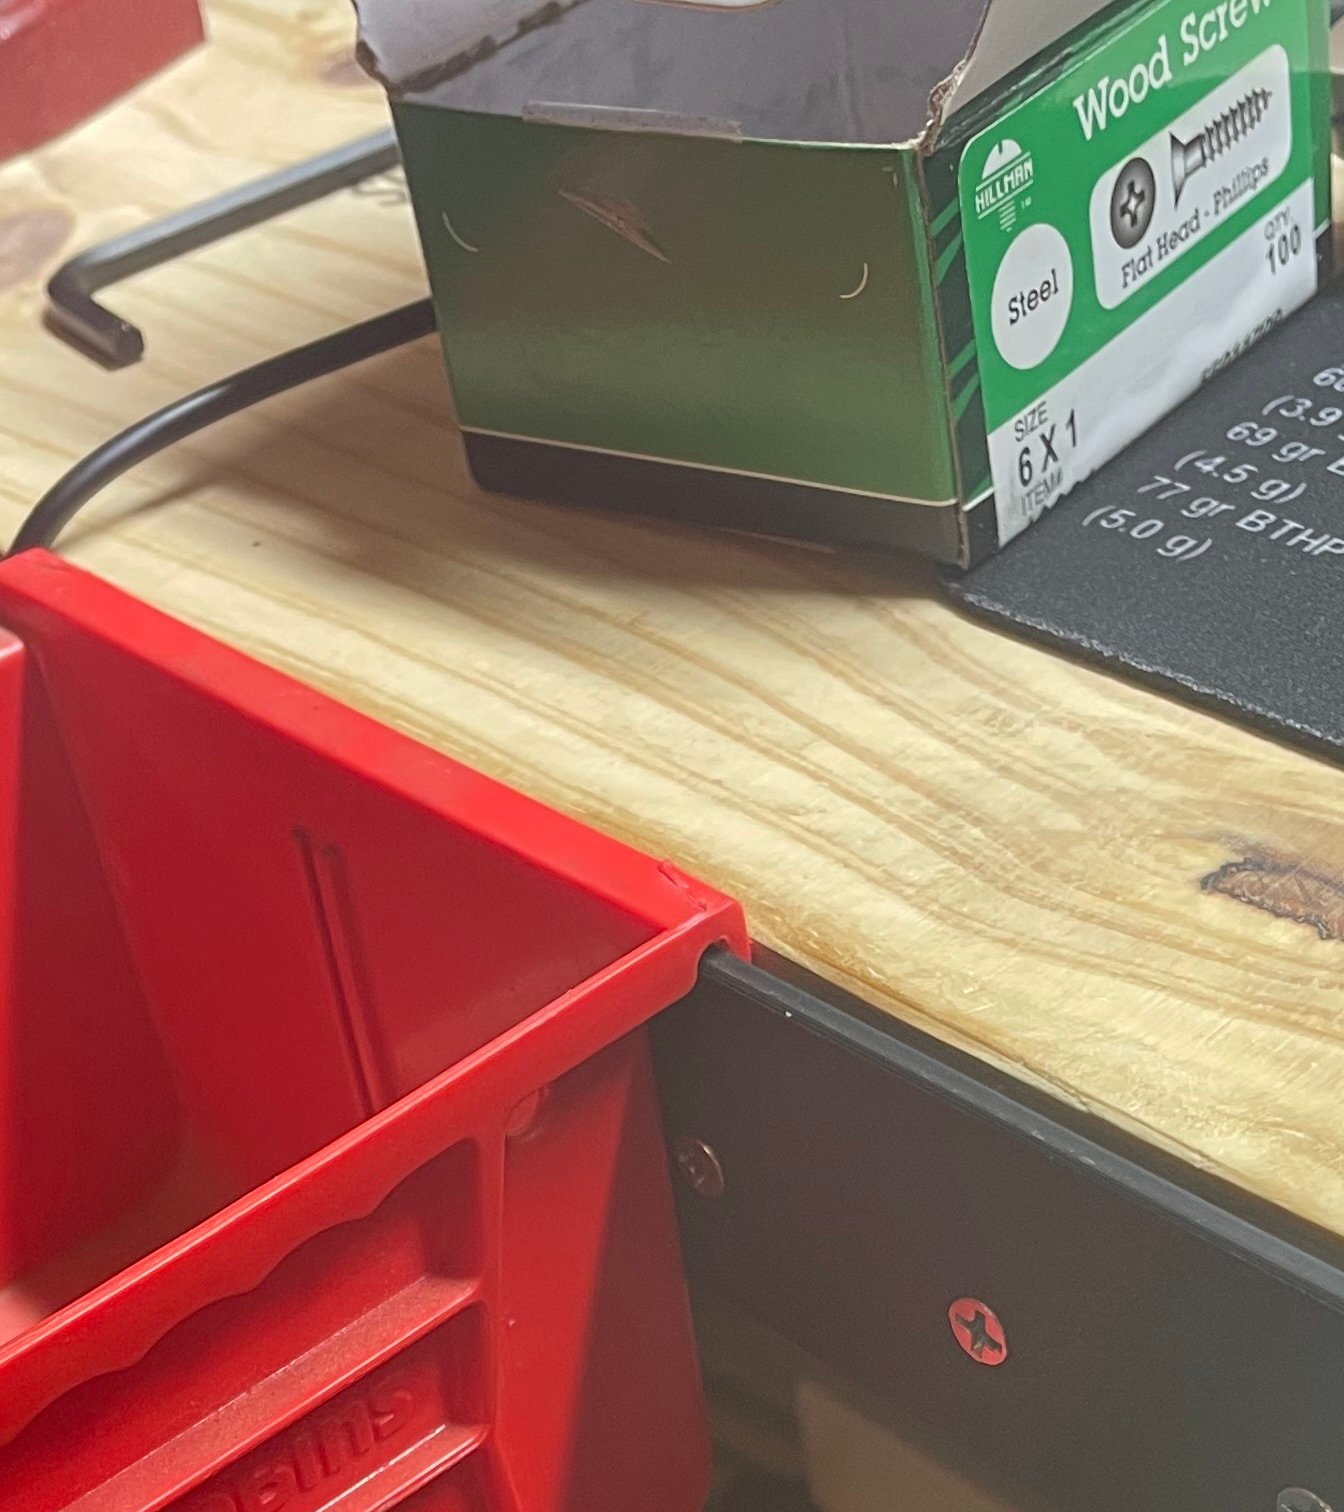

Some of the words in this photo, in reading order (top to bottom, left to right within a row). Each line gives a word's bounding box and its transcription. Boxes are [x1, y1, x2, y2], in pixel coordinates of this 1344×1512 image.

[1073, 34, 1173, 141] Wood
[975, 157, 1033, 213] HILLMAN
[1121, 246, 1153, 289] Flat
[1156, 207, 1201, 261] Head
[1212, 157, 1269, 215] Phillips
[1266, 224, 1301, 275] 100
[1008, 268, 1059, 326] Steel
[1015, 401, 1048, 442] SIZE
[1261, 395, 1343, 427] (3.9
[1019, 446, 1032, 487] 6
[1040, 423, 1058, 473] X
[1065, 408, 1077, 448] 1
[1226, 422, 1278, 447] 69
[1271, 441, 1326, 462] gr
[1136, 475, 1191, 500] 77
[1181, 497, 1236, 518] gr
[1174, 449, 1259, 484] (4.5
[1251, 479, 1307, 504] g)
[1082, 505, 1165, 539] (5.0
[1156, 535, 1213, 563] g)
